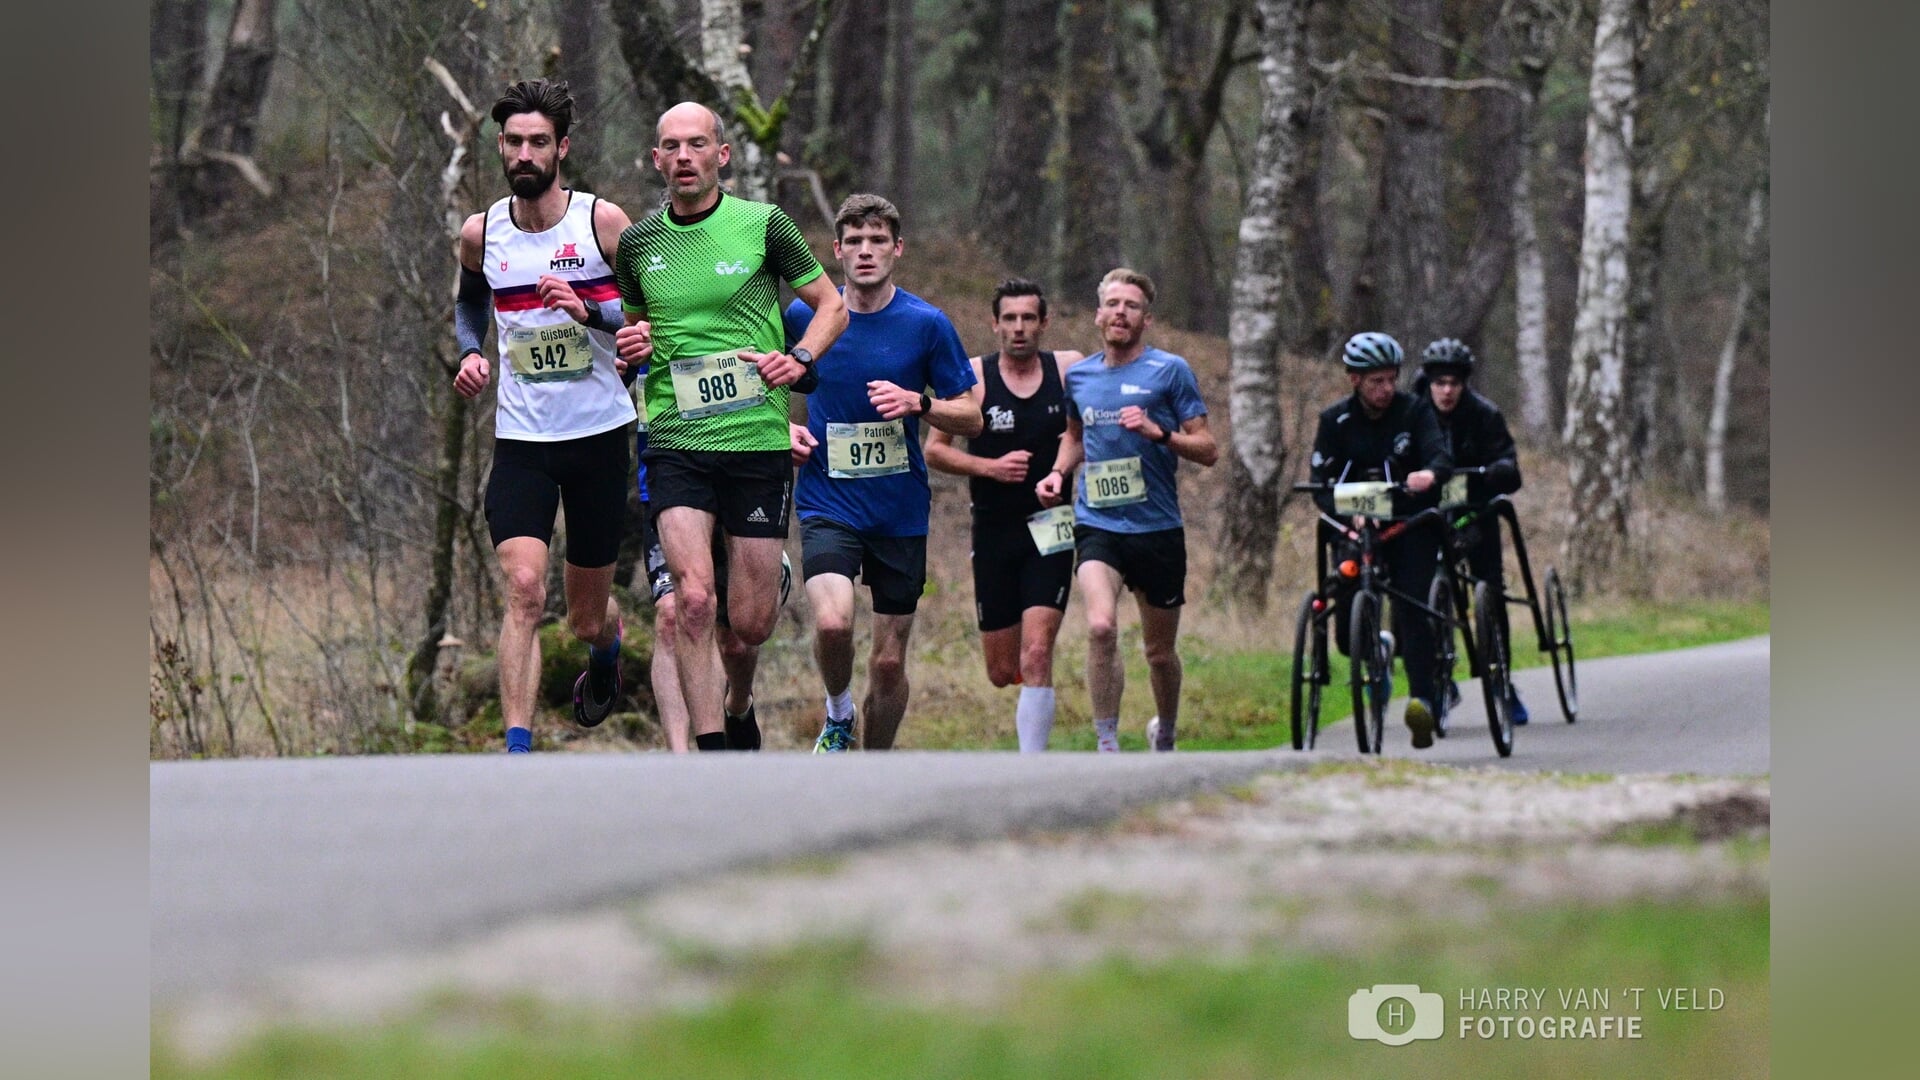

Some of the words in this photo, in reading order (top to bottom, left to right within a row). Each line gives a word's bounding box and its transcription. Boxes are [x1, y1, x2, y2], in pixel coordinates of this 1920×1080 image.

[550, 257, 585, 270] MTFU
[540, 325, 578, 341] Gijsbert
[530, 343, 568, 370] 542
[716, 356, 737, 370] Tom
[698, 372, 738, 403] 988
[864, 425, 896, 438] Patrick
[850, 441, 886, 466] 973
[1095, 475, 1130, 497] 1086
